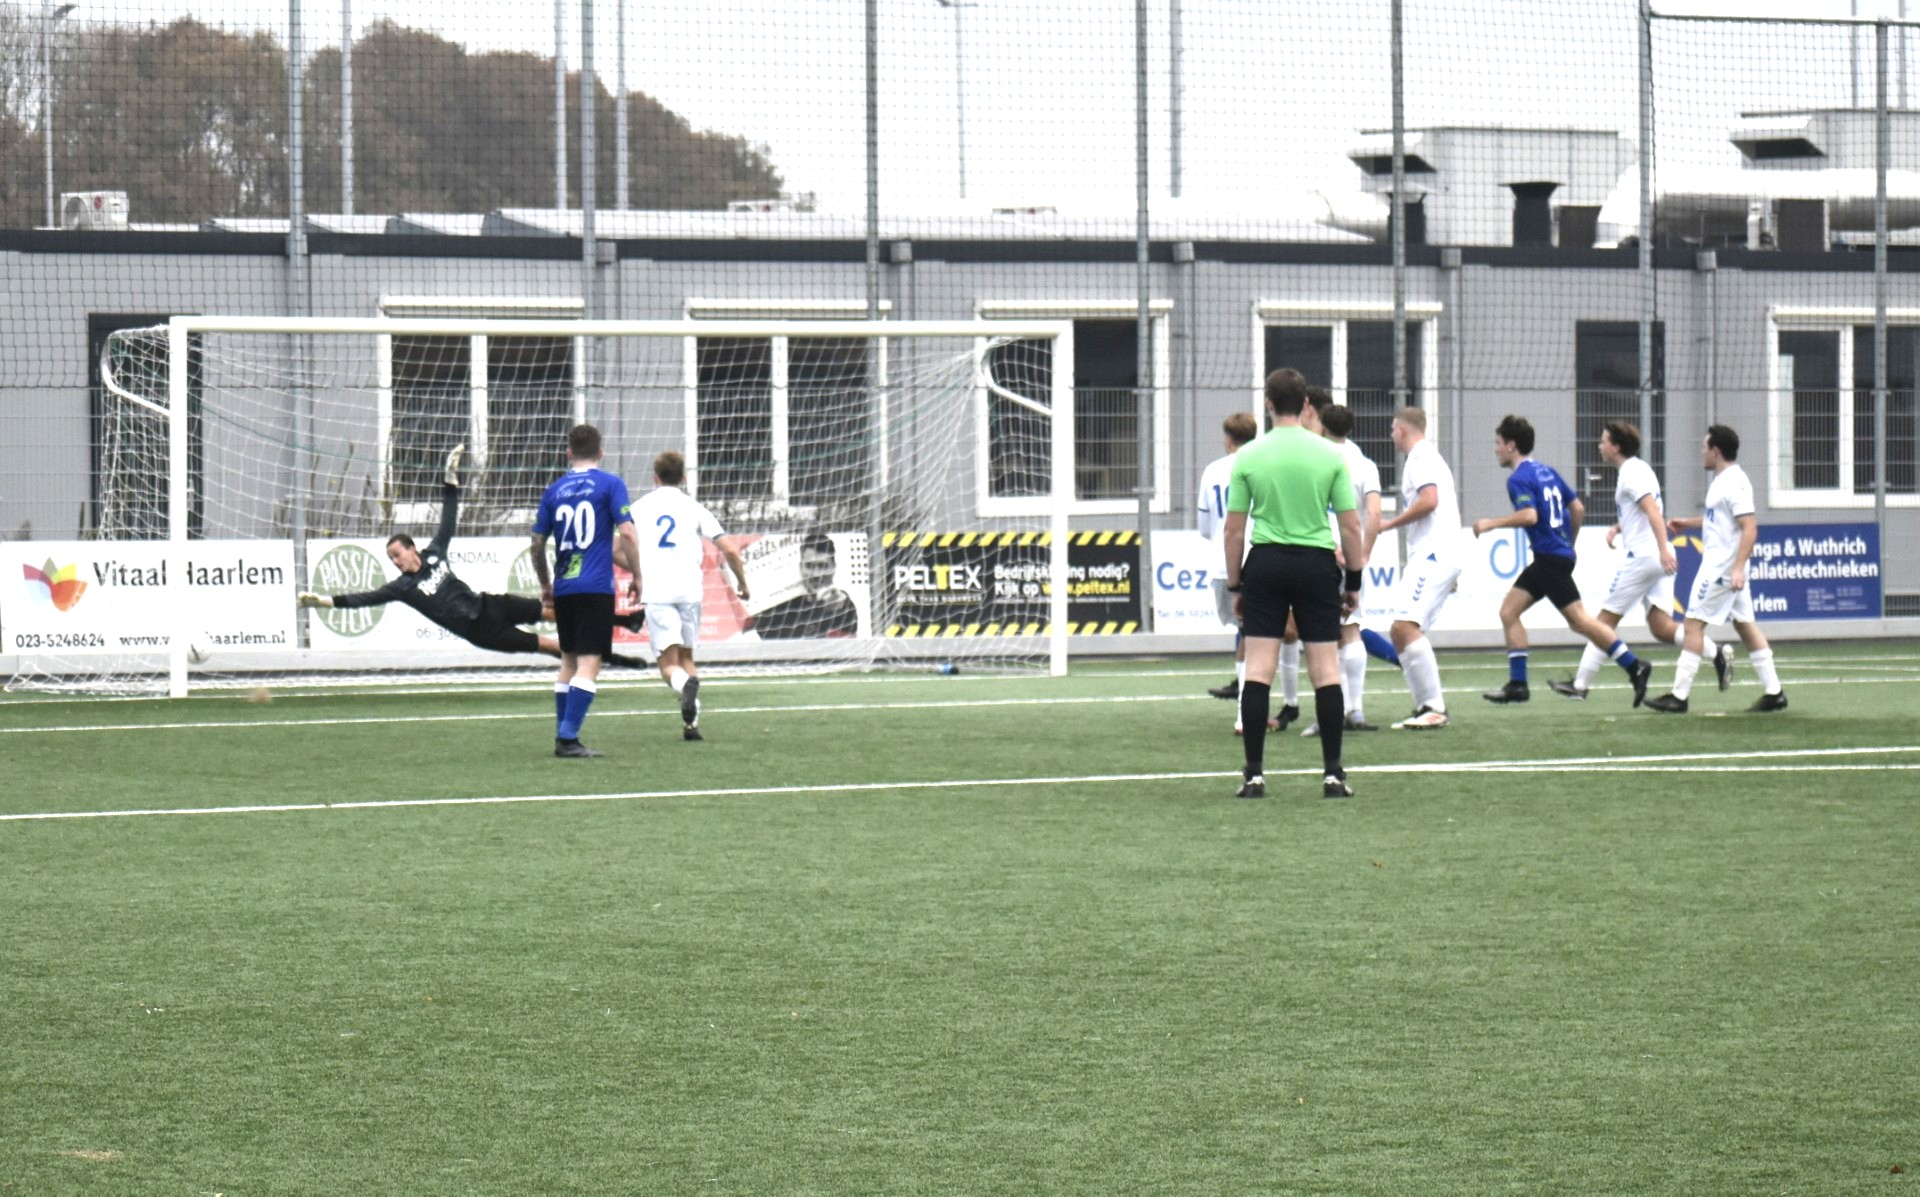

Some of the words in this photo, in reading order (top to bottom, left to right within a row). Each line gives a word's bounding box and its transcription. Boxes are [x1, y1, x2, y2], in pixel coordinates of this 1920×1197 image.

[555, 500, 596, 551] 20
[656, 515, 676, 548] 2
[449, 551, 501, 563] ENDAAL
[1751, 542, 1781, 561] nga
[1784, 539, 1796, 557] &
[1799, 534, 1867, 556] Wuthrich
[93, 560, 167, 586] Vitaal
[320, 551, 384, 591] PASSIE
[894, 563, 982, 590] PELTEX
[1088, 561, 1130, 581] nodig?
[1748, 559, 1879, 581] allatietechnieken
[994, 582, 1019, 598] Kijk
[1022, 584, 1039, 597] op
[1753, 592, 1788, 612] rlem
[15, 632, 105, 648] 023-5248624
